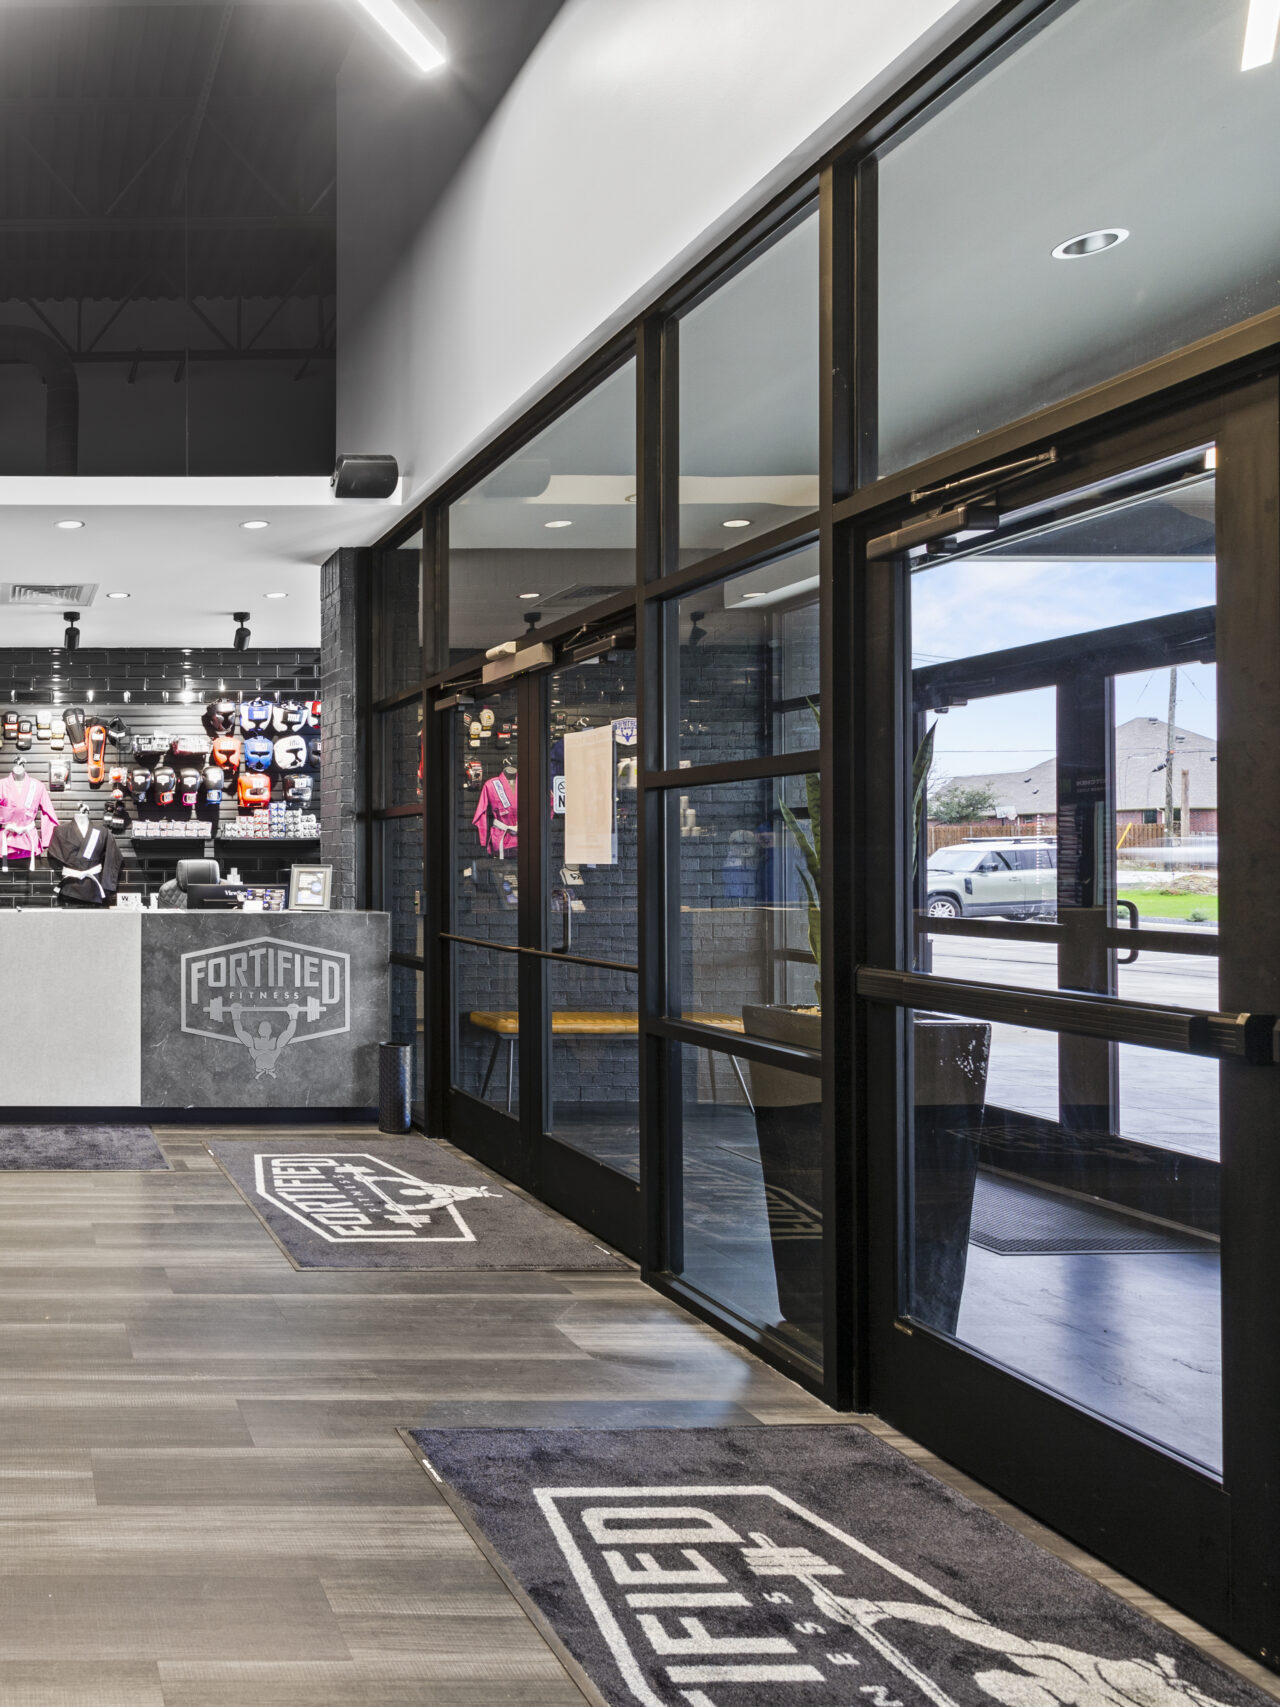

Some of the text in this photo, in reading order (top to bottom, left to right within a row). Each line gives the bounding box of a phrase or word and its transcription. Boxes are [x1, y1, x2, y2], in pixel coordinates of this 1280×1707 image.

[190, 948, 340, 1004] FORTIFIED
[229, 991, 300, 1000] FITNESS
[271, 1158, 417, 1236] FORTIFIED
[333, 1174, 382, 1212] FITNESS
